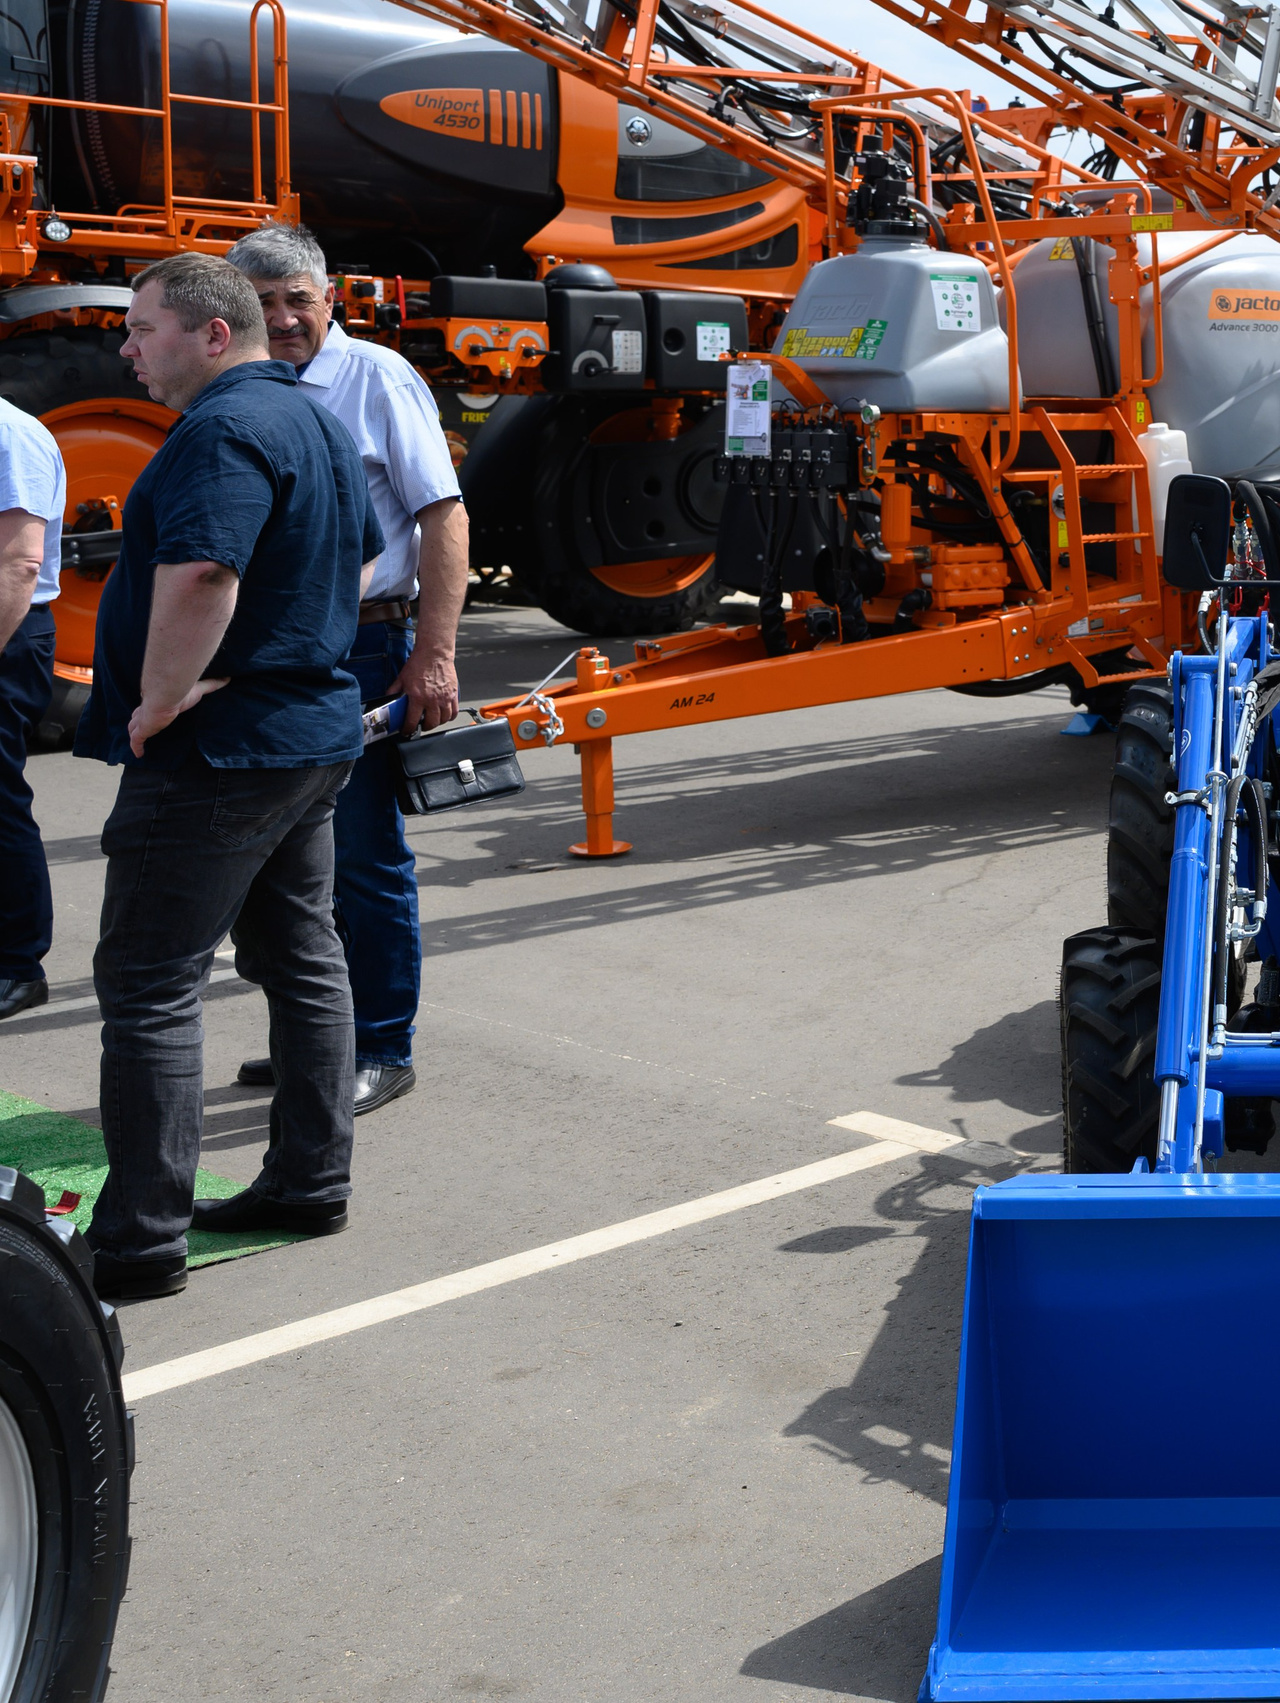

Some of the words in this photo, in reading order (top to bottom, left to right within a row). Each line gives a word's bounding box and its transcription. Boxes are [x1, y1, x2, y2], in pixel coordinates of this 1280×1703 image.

[414, 94, 480, 113] Uniport
[433, 113, 480, 129] 4530
[1232, 297, 1280, 313] jacto
[1209, 322, 1250, 332] Advance
[1252, 323, 1278, 333] 3000
[462, 411, 490, 423] FRIE
[669, 696, 694, 710] AM
[695, 692, 716, 706] 24
